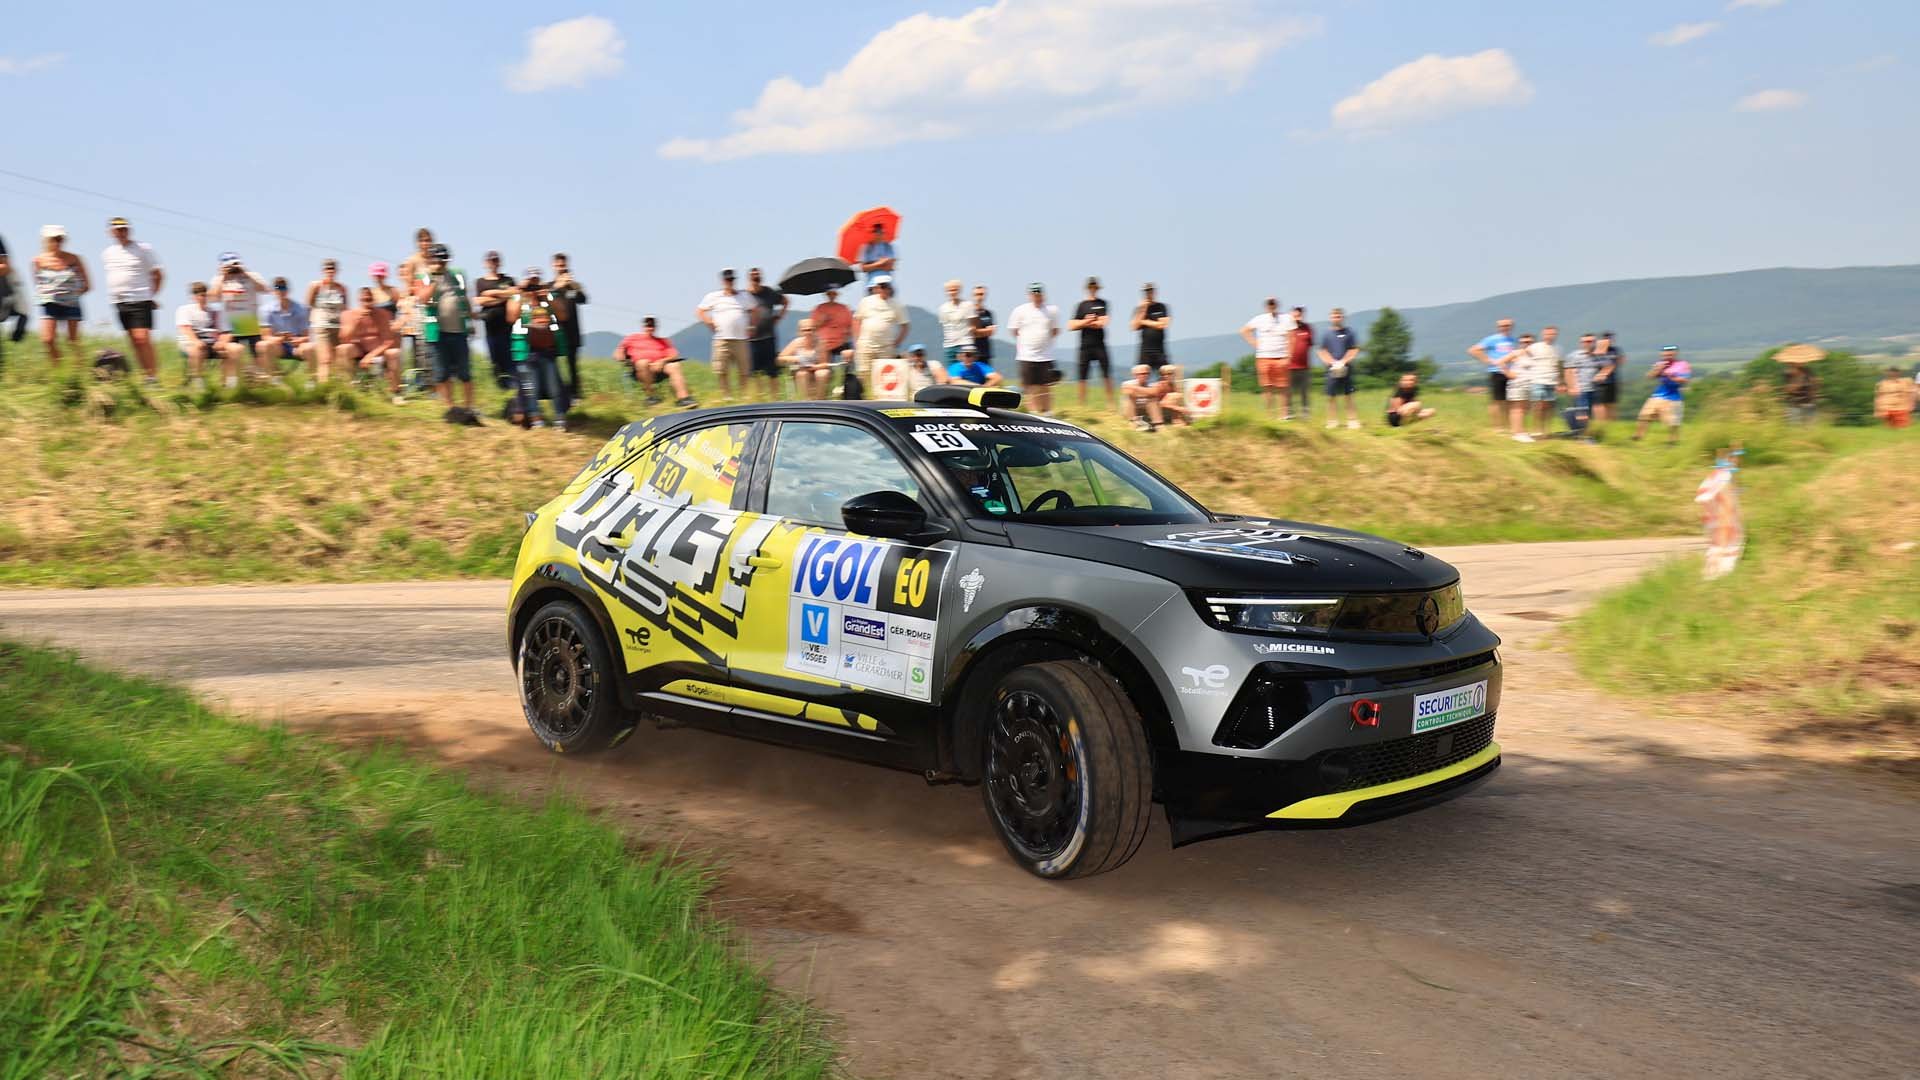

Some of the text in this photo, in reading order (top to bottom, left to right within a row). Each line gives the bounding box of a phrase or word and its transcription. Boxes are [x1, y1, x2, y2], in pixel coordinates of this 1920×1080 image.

[915, 423, 960, 432] ADAC
[960, 423, 999, 432] OPEL
[794, 538, 882, 604] IGOL
[1269, 643, 1336, 655] MICHELIN
[801, 651, 828, 664] VOSGES
[1418, 690, 1473, 716] SECURITEST
